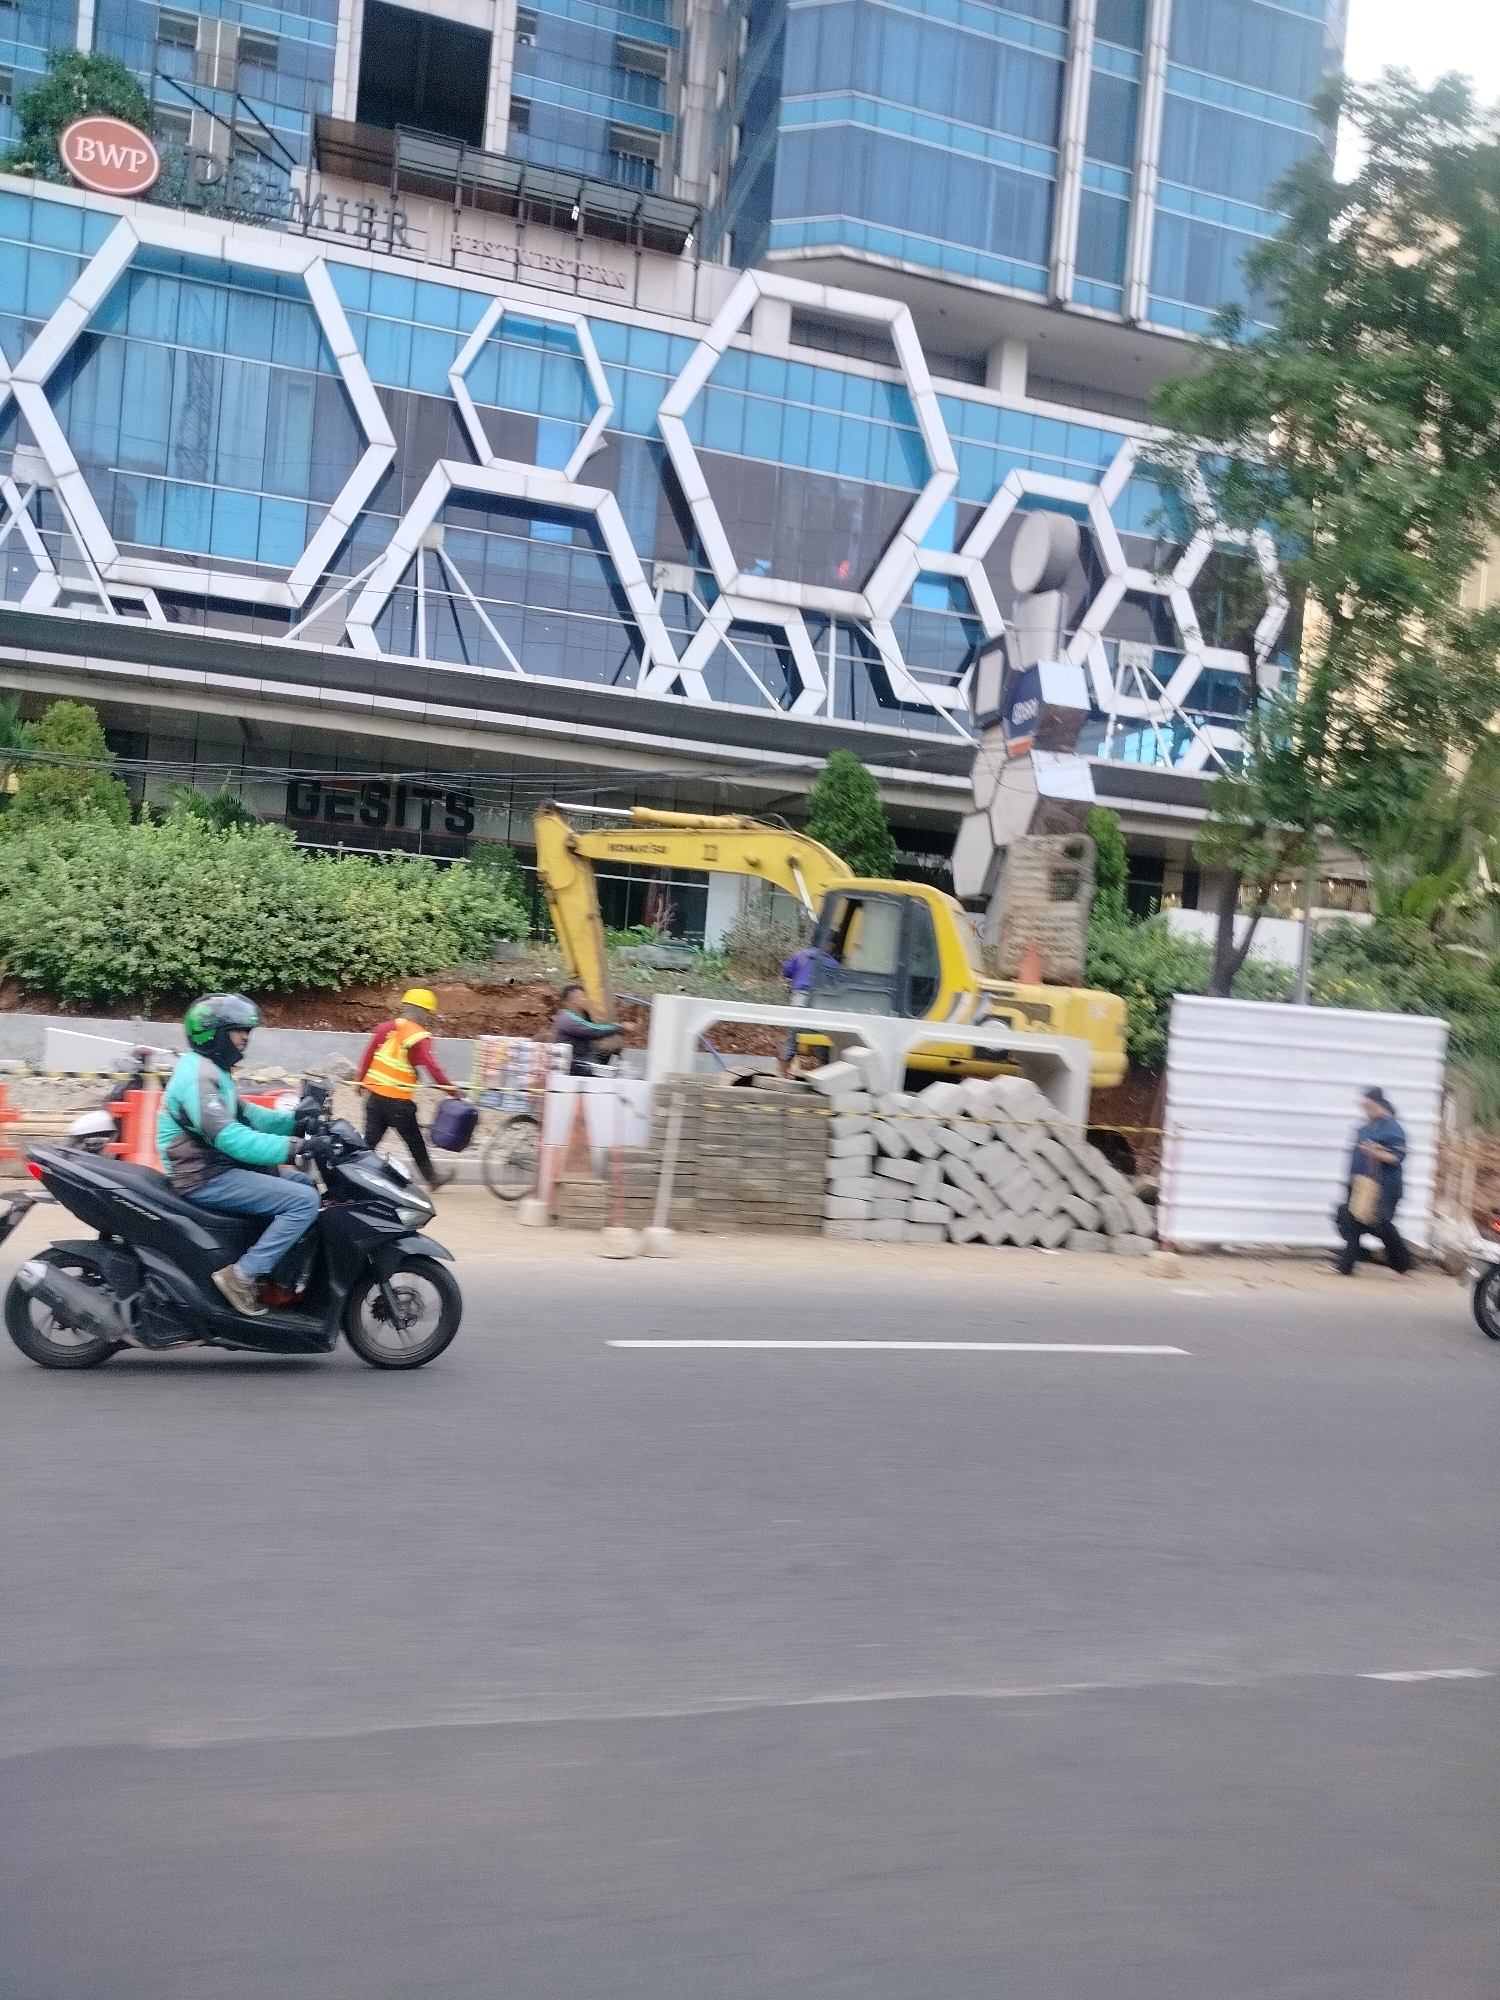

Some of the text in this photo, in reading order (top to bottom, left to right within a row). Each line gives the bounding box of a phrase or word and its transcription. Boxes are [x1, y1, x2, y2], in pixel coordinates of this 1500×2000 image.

[74, 135, 149, 175] BWP
[184, 149, 412, 250] PREMIER
[451, 233, 627, 290] BEST WESTERN
[286, 778, 476, 835] GESITS
